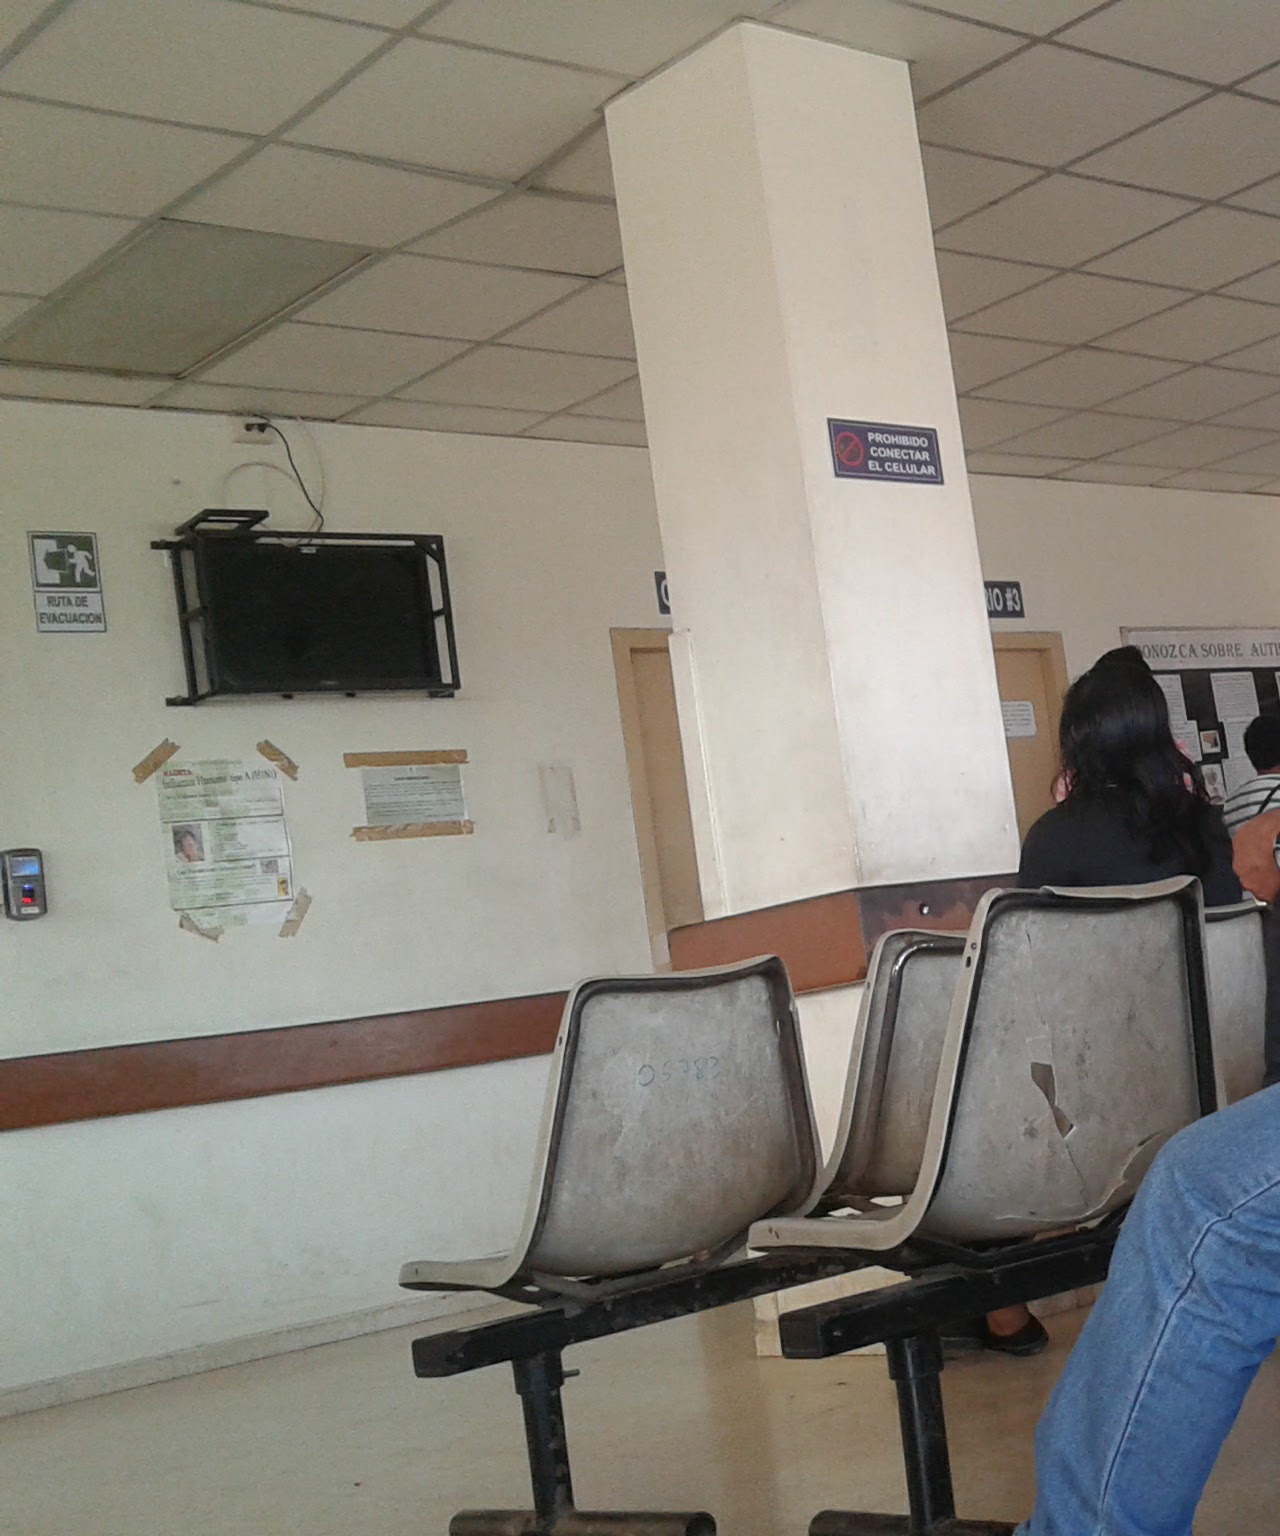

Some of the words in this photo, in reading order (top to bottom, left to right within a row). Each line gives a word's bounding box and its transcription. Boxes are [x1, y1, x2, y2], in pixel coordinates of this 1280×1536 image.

[867, 432, 928, 447] PROHIBIDO
[870, 447, 930, 461] CONECTAR
[867, 460, 883, 472] EL
[884, 462, 936, 475] CELULAR
[47, 595, 73, 608] RUTA
[75, 596, 88, 608] DE
[1005, 587, 1021, 611] #3
[1200, 643, 1243, 659] SOBRE
